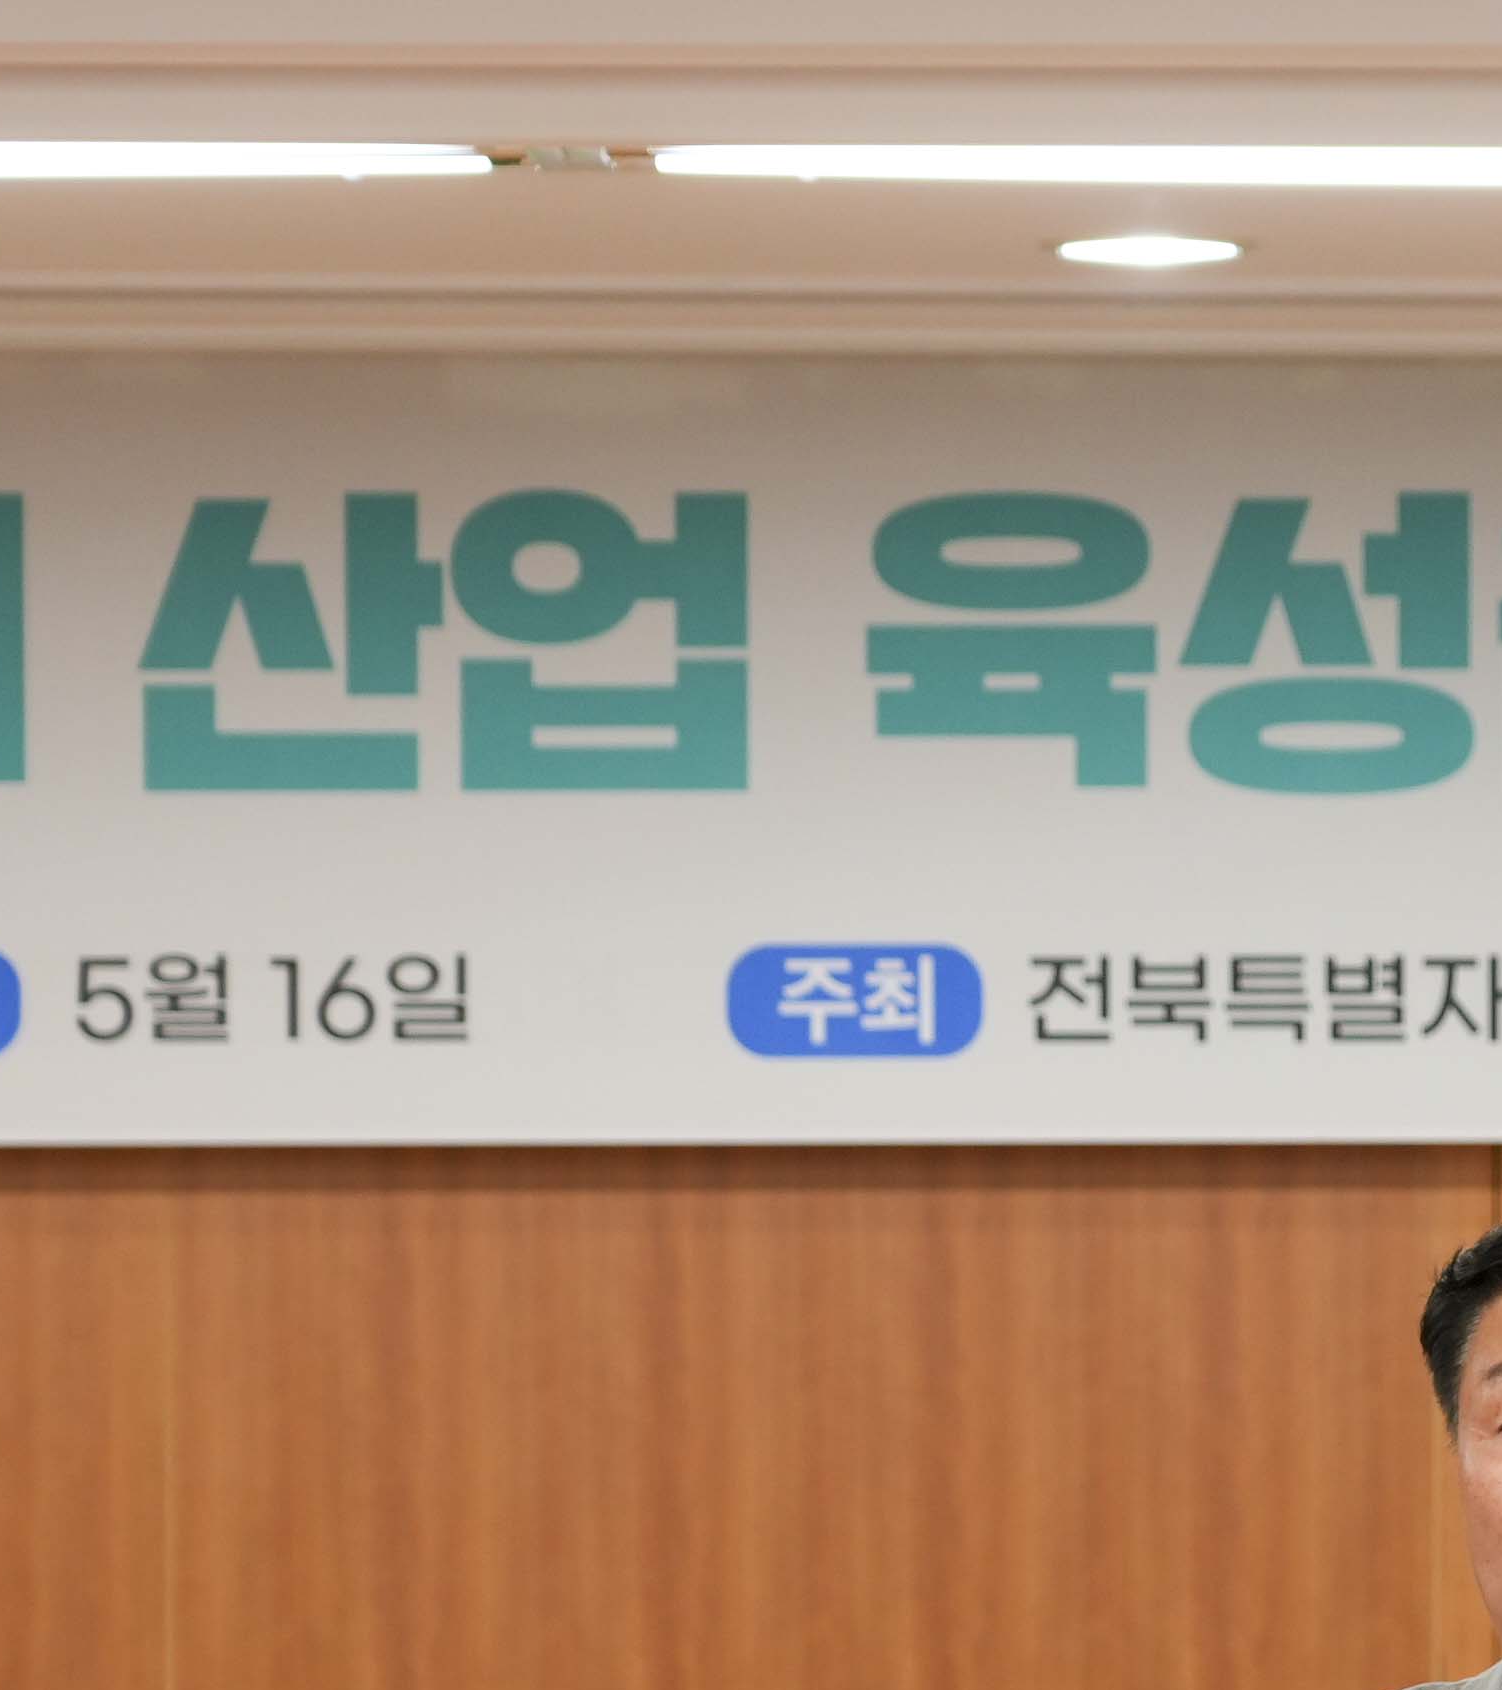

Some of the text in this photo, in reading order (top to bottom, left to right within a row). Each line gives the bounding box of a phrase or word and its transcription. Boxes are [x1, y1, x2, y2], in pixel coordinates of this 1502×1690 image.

[138, 489, 751, 794] 산업
[75, 954, 469, 1042] 5월 16일
[775, 955, 940, 1046] 주최
